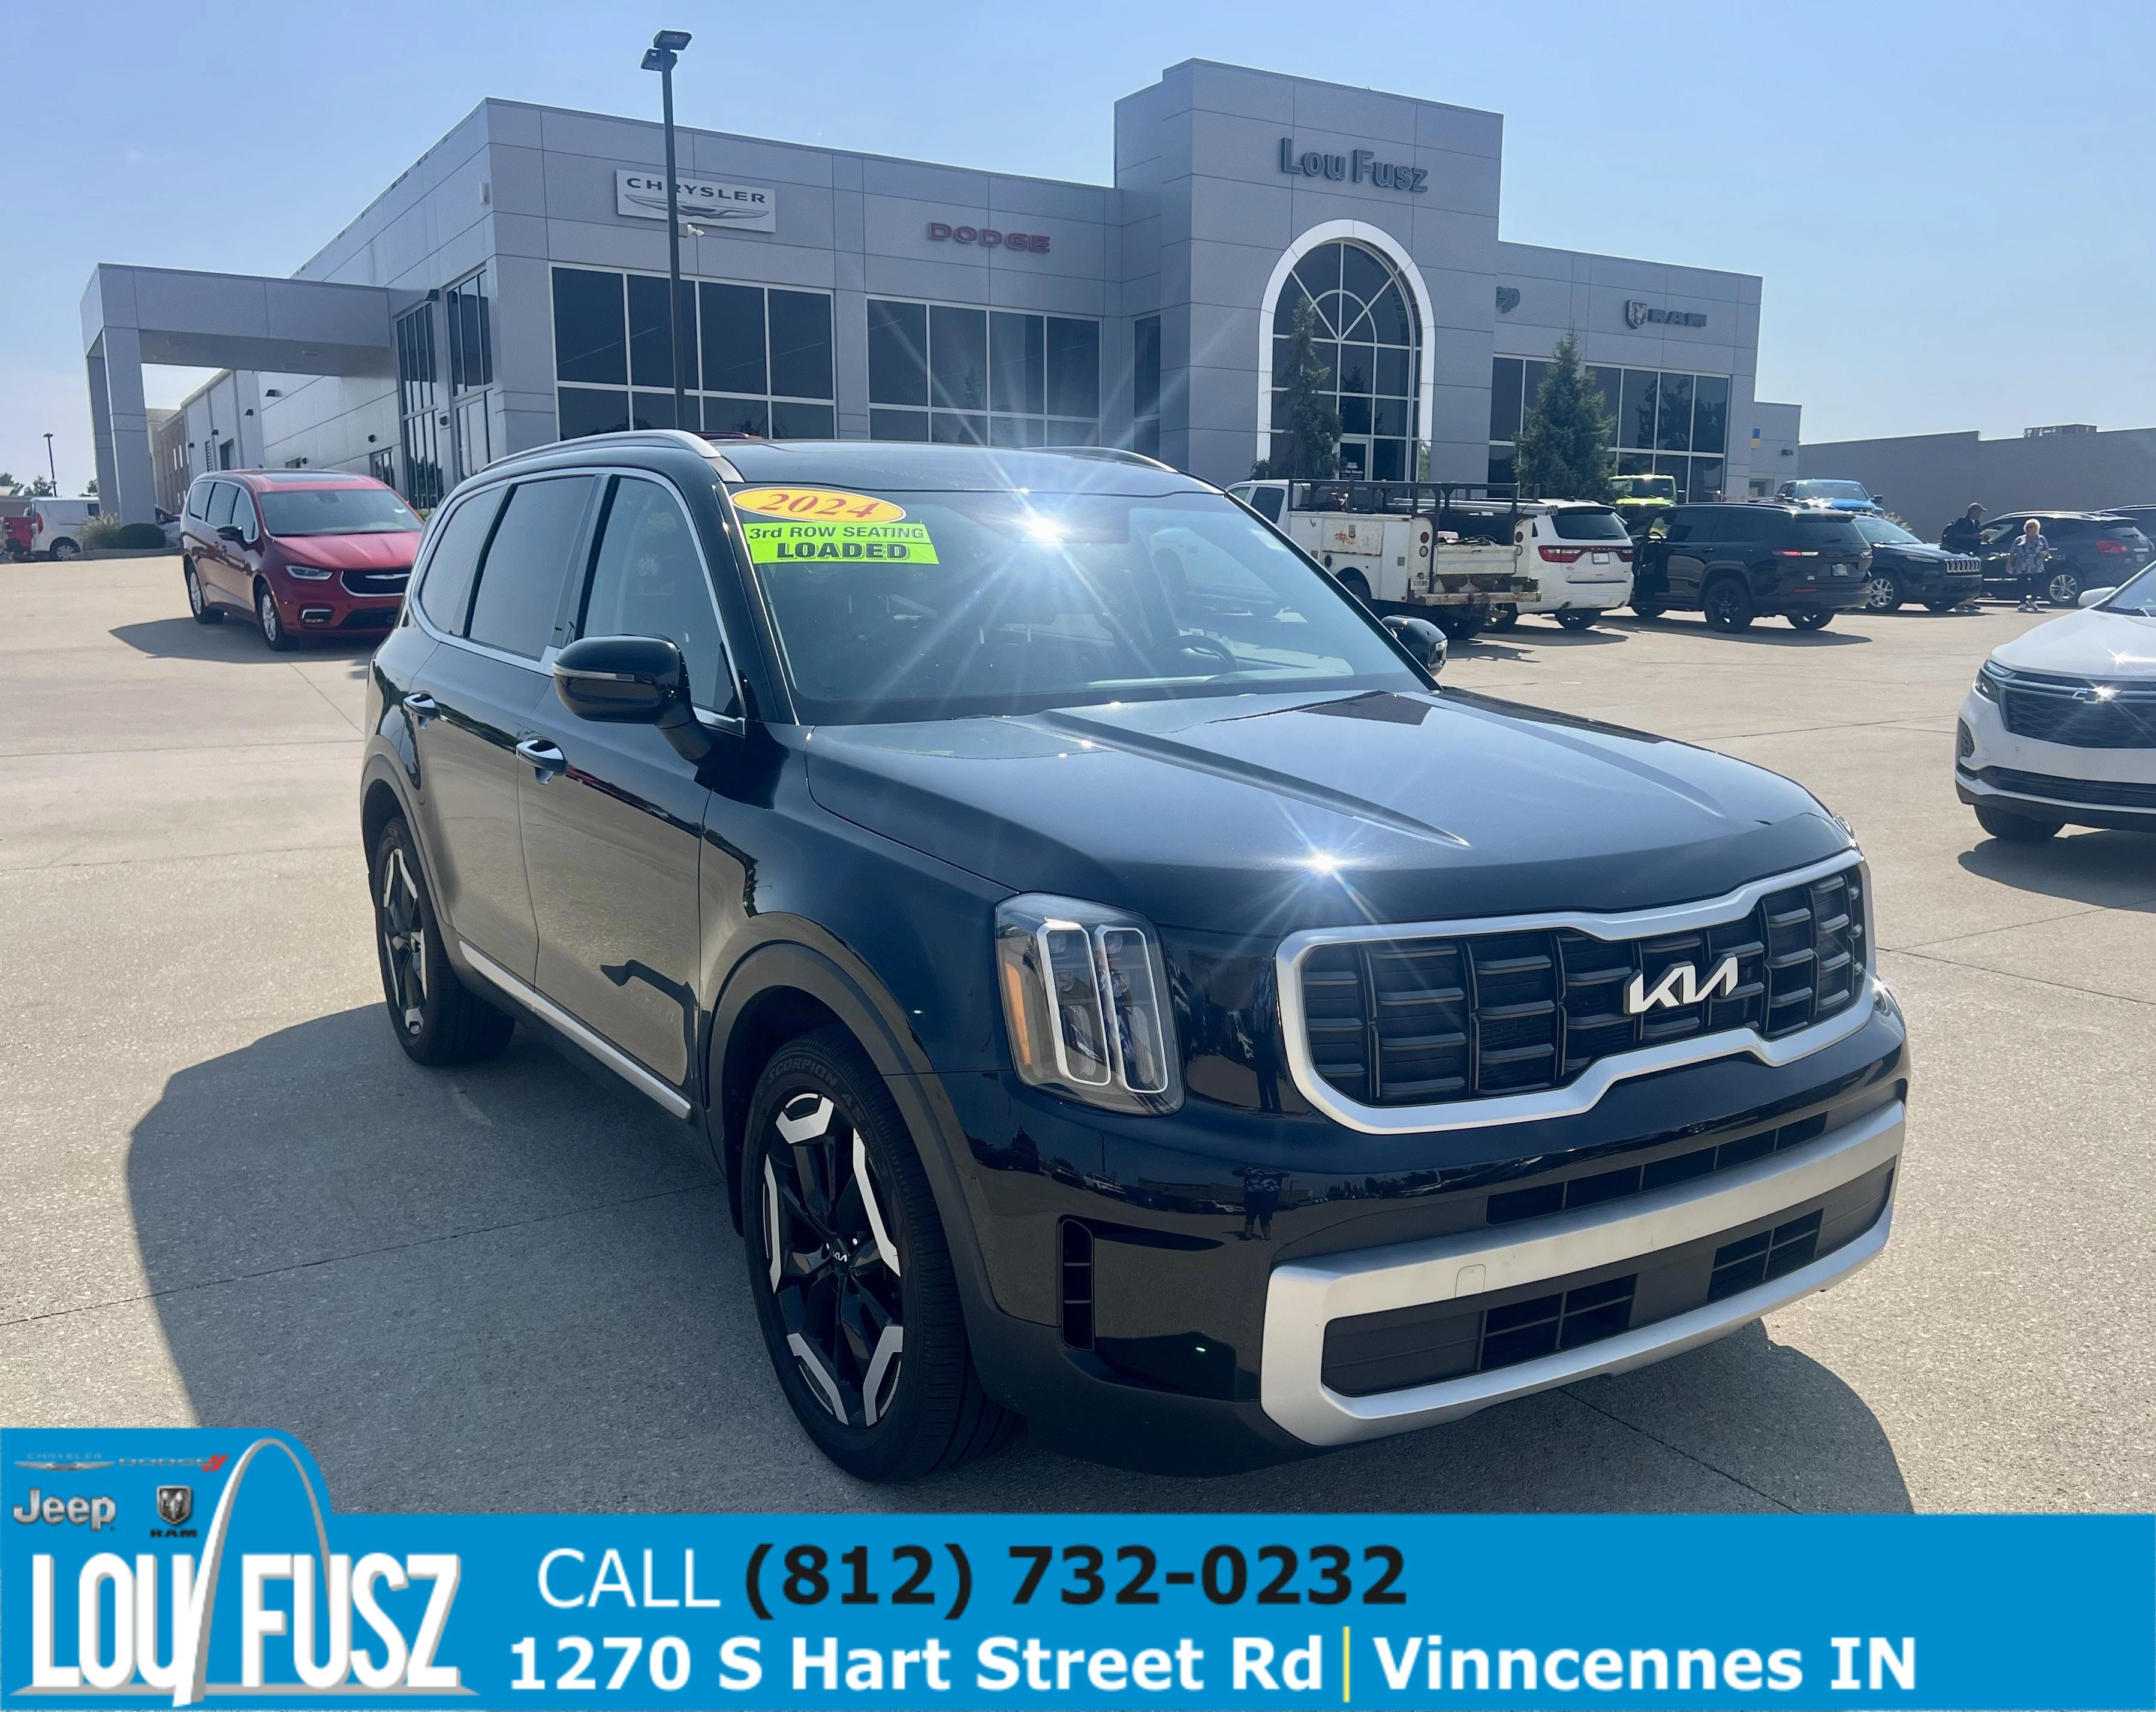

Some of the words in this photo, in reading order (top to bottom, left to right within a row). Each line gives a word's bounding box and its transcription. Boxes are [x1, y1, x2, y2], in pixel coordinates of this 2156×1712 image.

[1281, 137, 1347, 180] Lou
[1352, 149, 1428, 192] Fusz
[928, 222, 1050, 254] DODGE
[1648, 309, 1707, 327] RAM
[757, 493, 880, 518] 2024
[750, 528, 782, 539] 3rd
[790, 527, 836, 537] ROW
[843, 527, 923, 538] SEATING
[777, 542, 911, 560] LOADED
[1623, 952, 1738, 1015] KIA
[769, 1057, 838, 1087] SCORPION
[841, 1093, 865, 1123] AS
